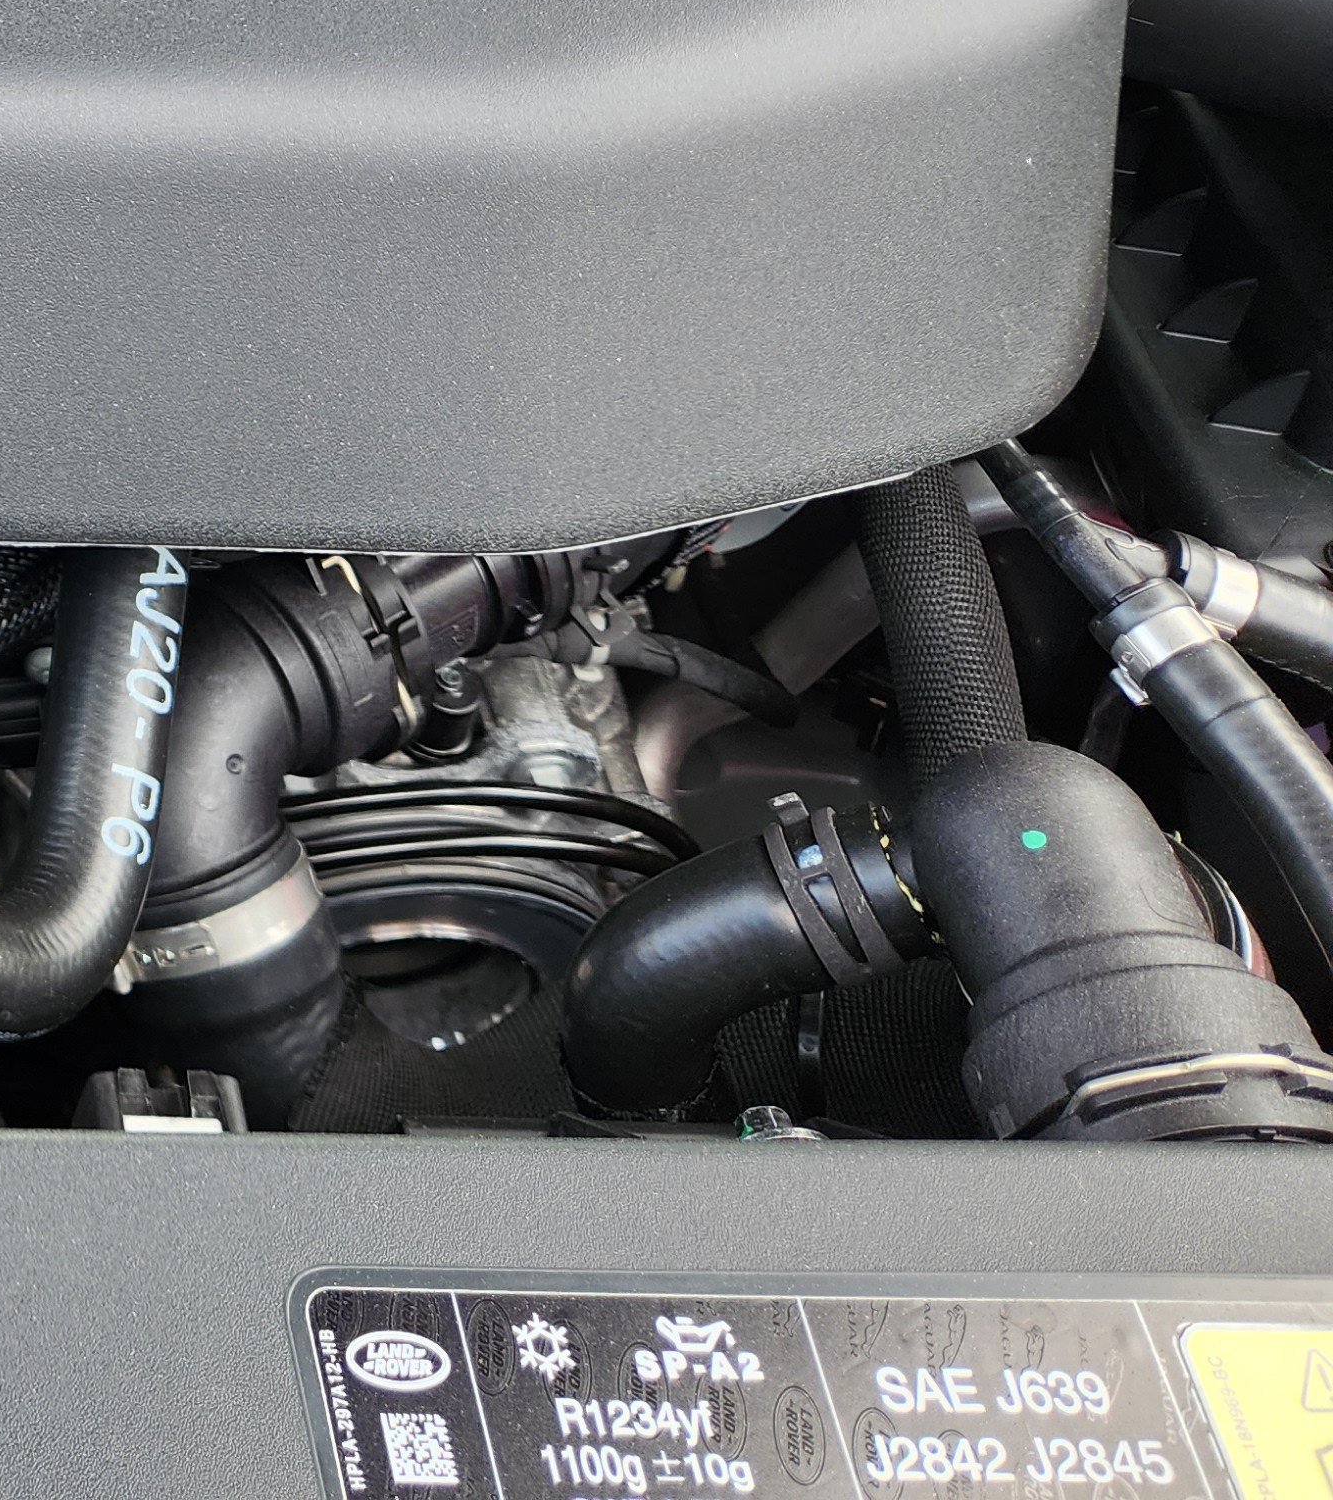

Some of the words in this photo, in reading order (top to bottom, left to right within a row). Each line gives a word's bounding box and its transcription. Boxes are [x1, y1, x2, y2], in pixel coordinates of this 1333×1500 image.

[367, 1342, 416, 1359] LAND
[373, 1357, 434, 1378] ROVER
[633, 1350, 765, 1381] SP-A2
[876, 1366, 986, 1414] SAE
[996, 1368, 1111, 1415] J639
[554, 1397, 715, 1448] R1234yf
[541, 1444, 648, 1494] 1100g
[867, 1434, 1015, 1483] J2842
[1026, 1437, 1175, 1486] J2845
